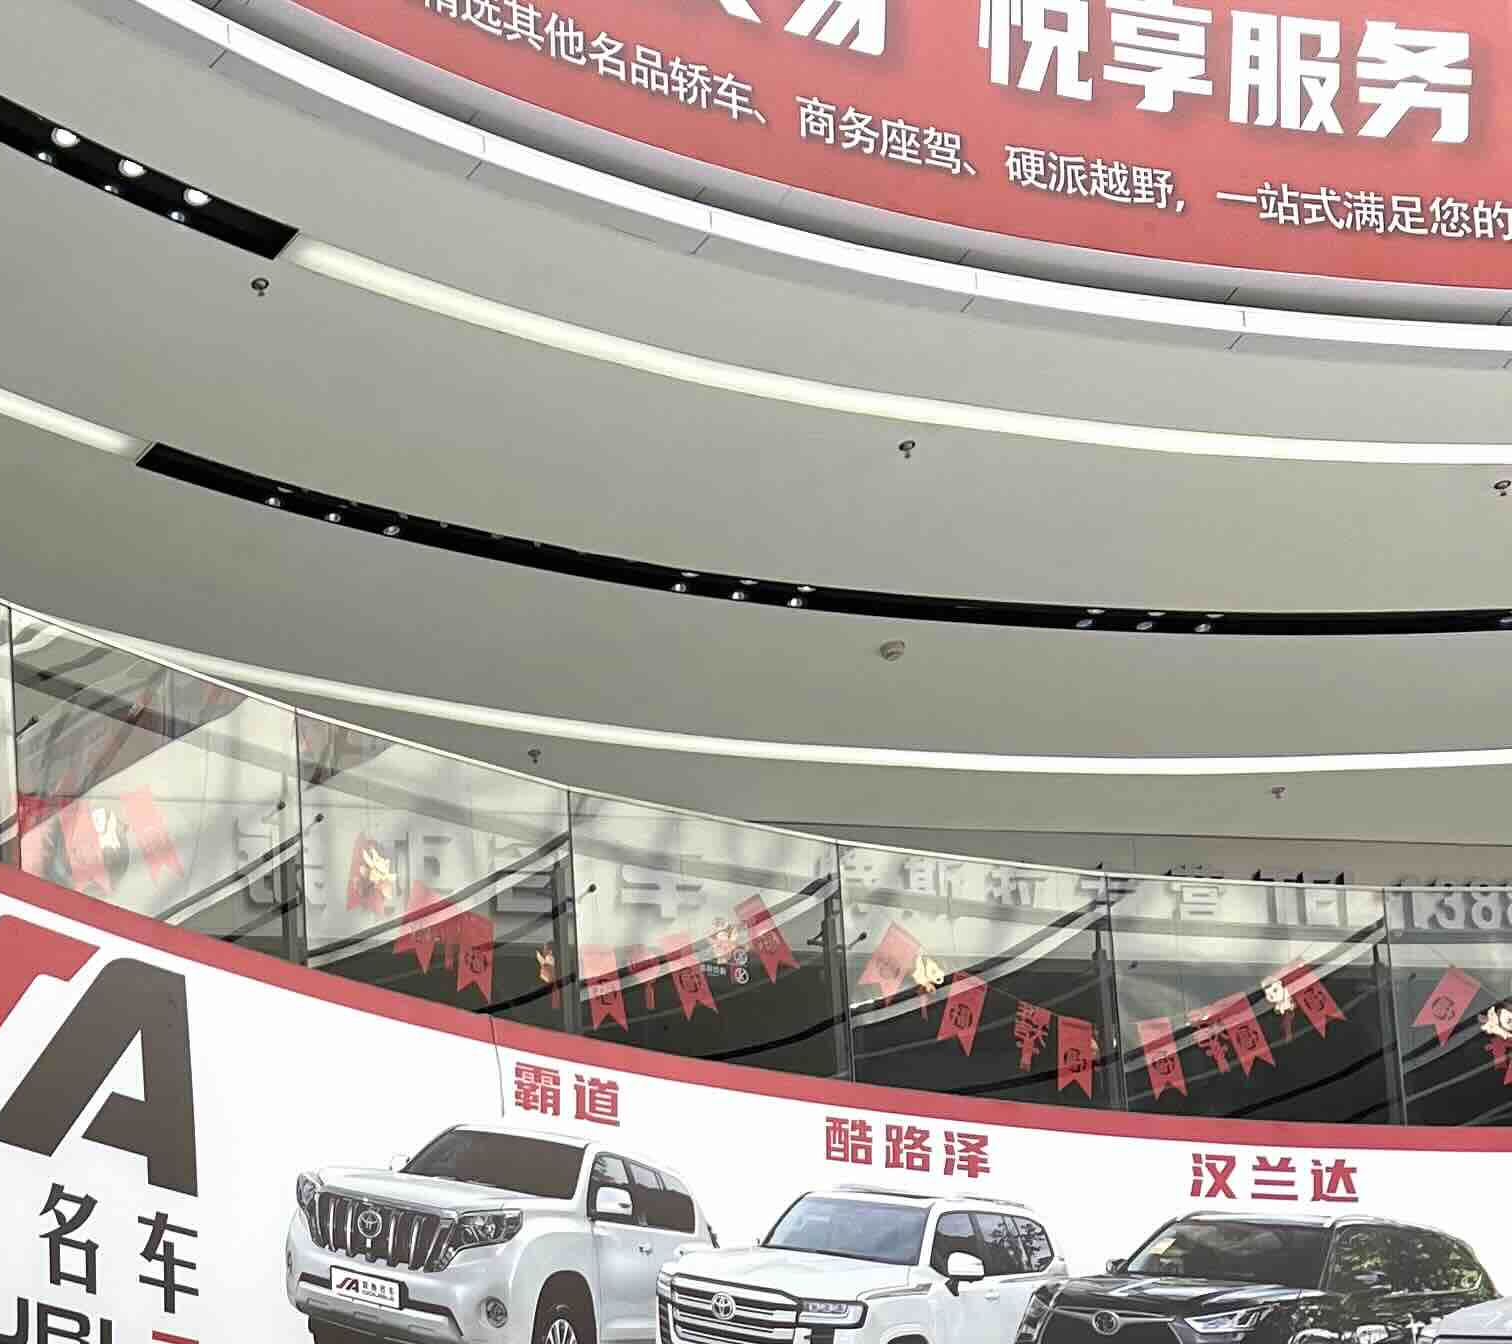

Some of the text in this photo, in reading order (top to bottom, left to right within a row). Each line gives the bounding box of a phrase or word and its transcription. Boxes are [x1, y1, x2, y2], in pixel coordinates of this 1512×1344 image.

[514, 1061, 620, 1127] 霸道
[825, 1116, 991, 1180] 酷路泽
[1190, 1152, 1359, 1203] 汉兰达
